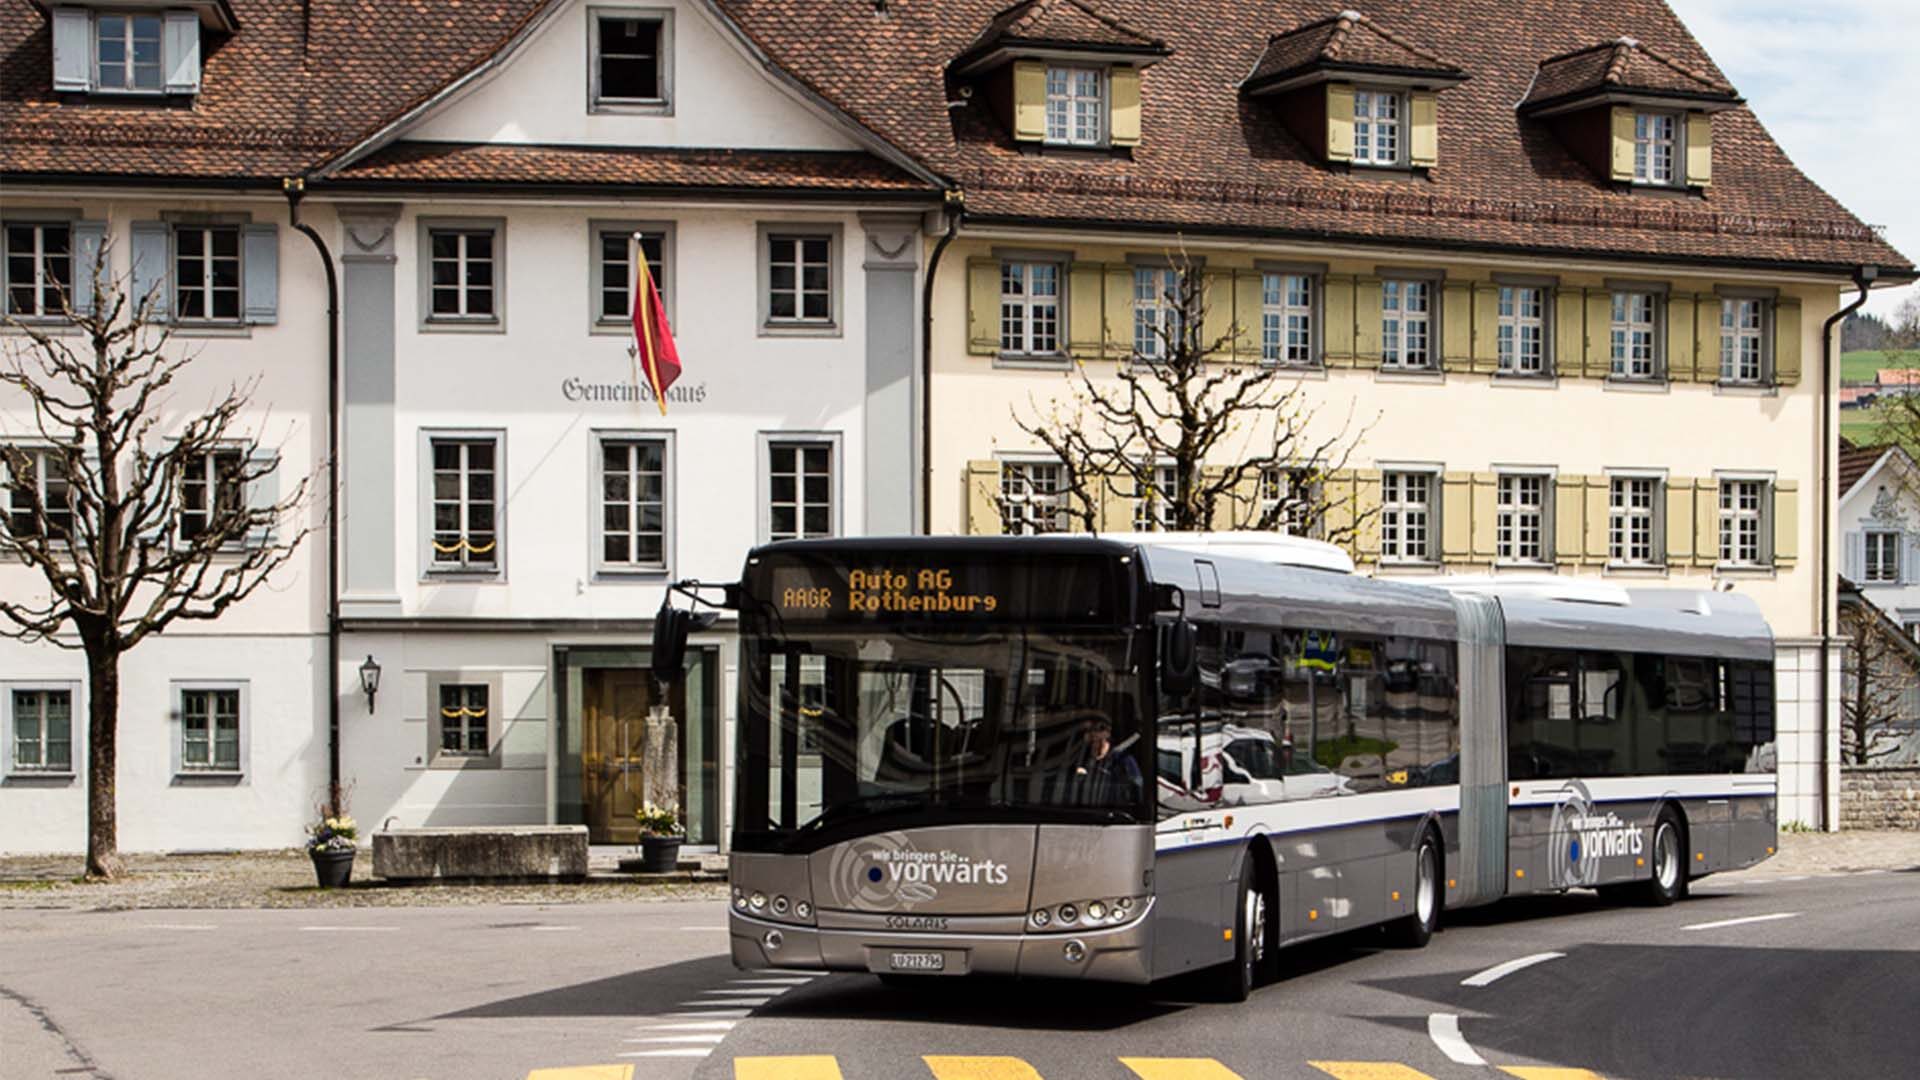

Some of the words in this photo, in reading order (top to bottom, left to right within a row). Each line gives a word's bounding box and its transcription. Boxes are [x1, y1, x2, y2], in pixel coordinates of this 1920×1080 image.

[561, 377, 706, 403] Gemeindaus
[849, 569, 908, 590] Auto
[917, 569, 952, 590] AG
[783, 588, 832, 609] AAGR
[849, 591, 997, 612] Rothenburg
[893, 849, 937, 865] bringen
[940, 850, 958, 862] Sie
[889, 856, 1008, 884] vorwärts
[885, 917, 949, 930] SOLARIS
